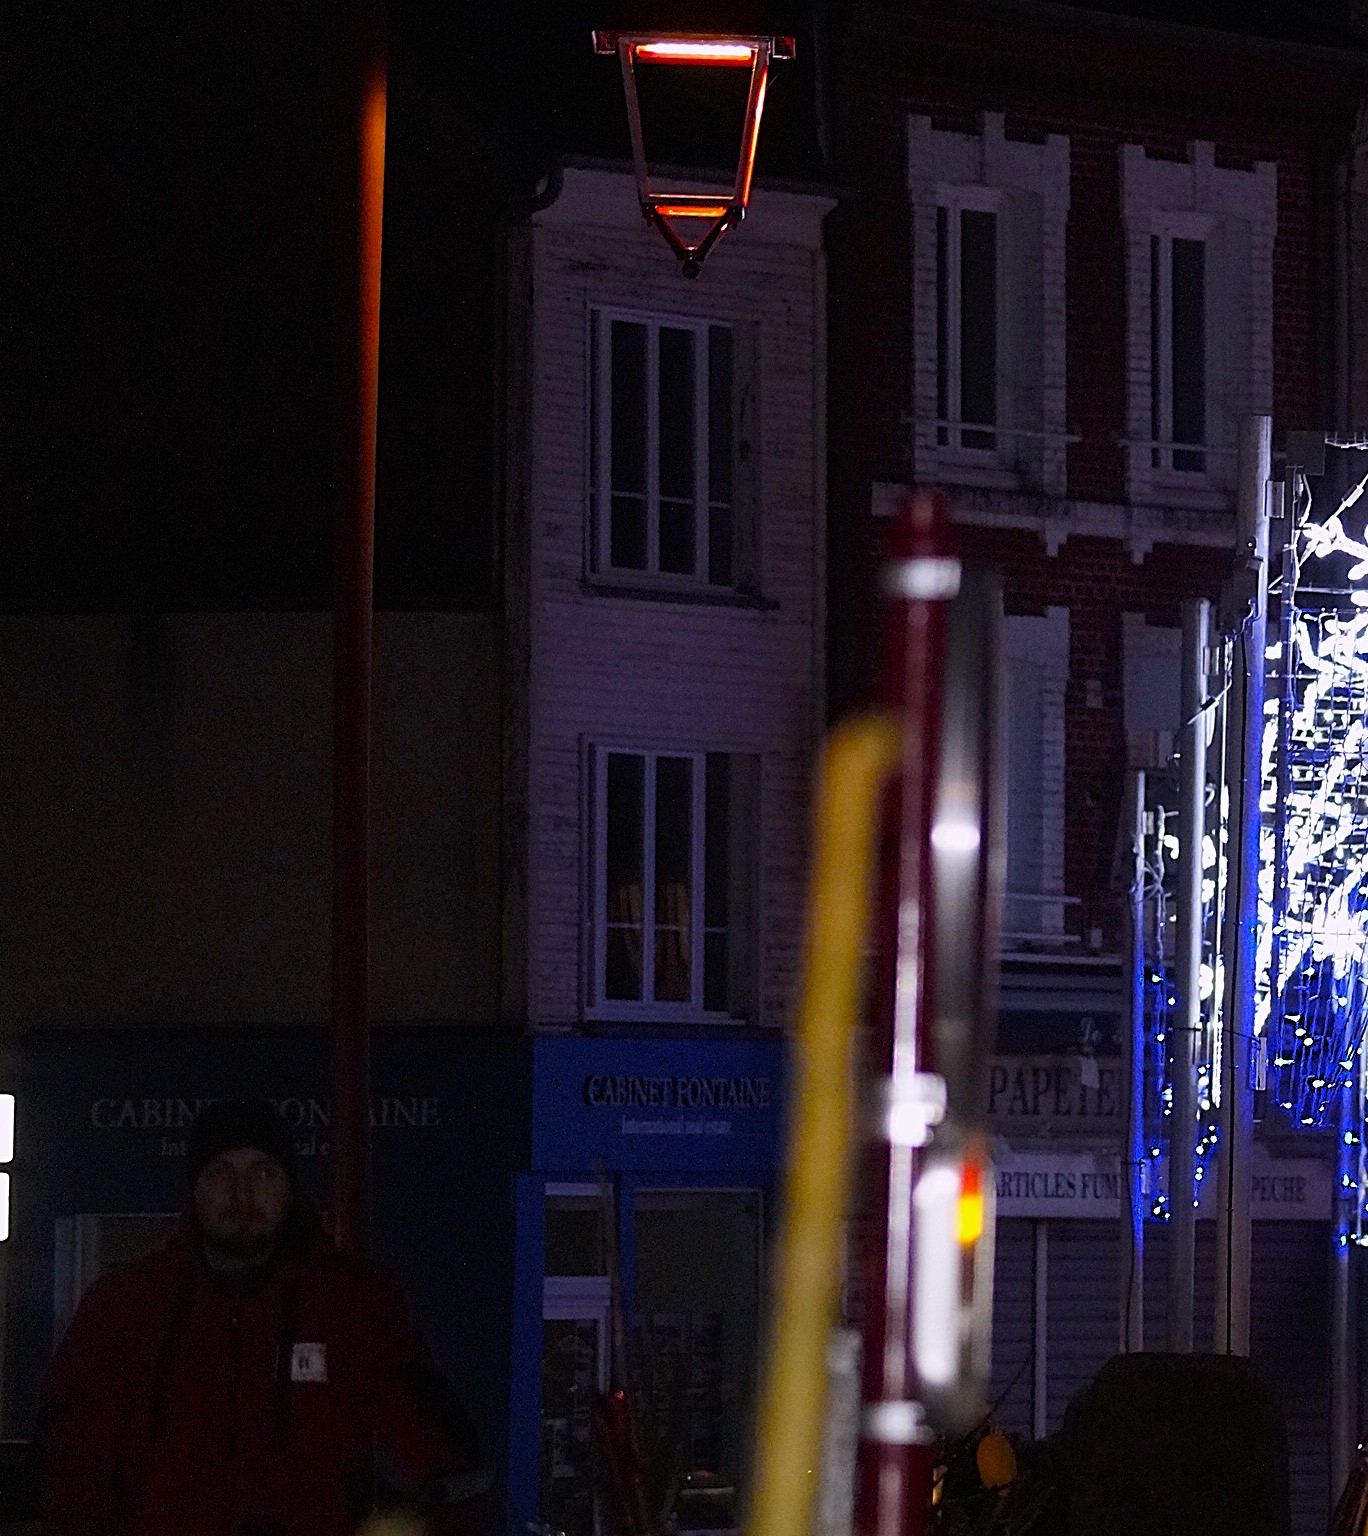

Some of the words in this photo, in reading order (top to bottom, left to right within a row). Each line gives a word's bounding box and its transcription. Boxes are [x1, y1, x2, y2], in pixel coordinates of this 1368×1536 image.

[586, 1075, 673, 1107] CABINET
[677, 1076, 770, 1108] FONTAINE
[986, 1065, 1123, 1117] PAPETE
[91, 1099, 220, 1129] CABIN
[1081, 1173, 1121, 1199] FUM
